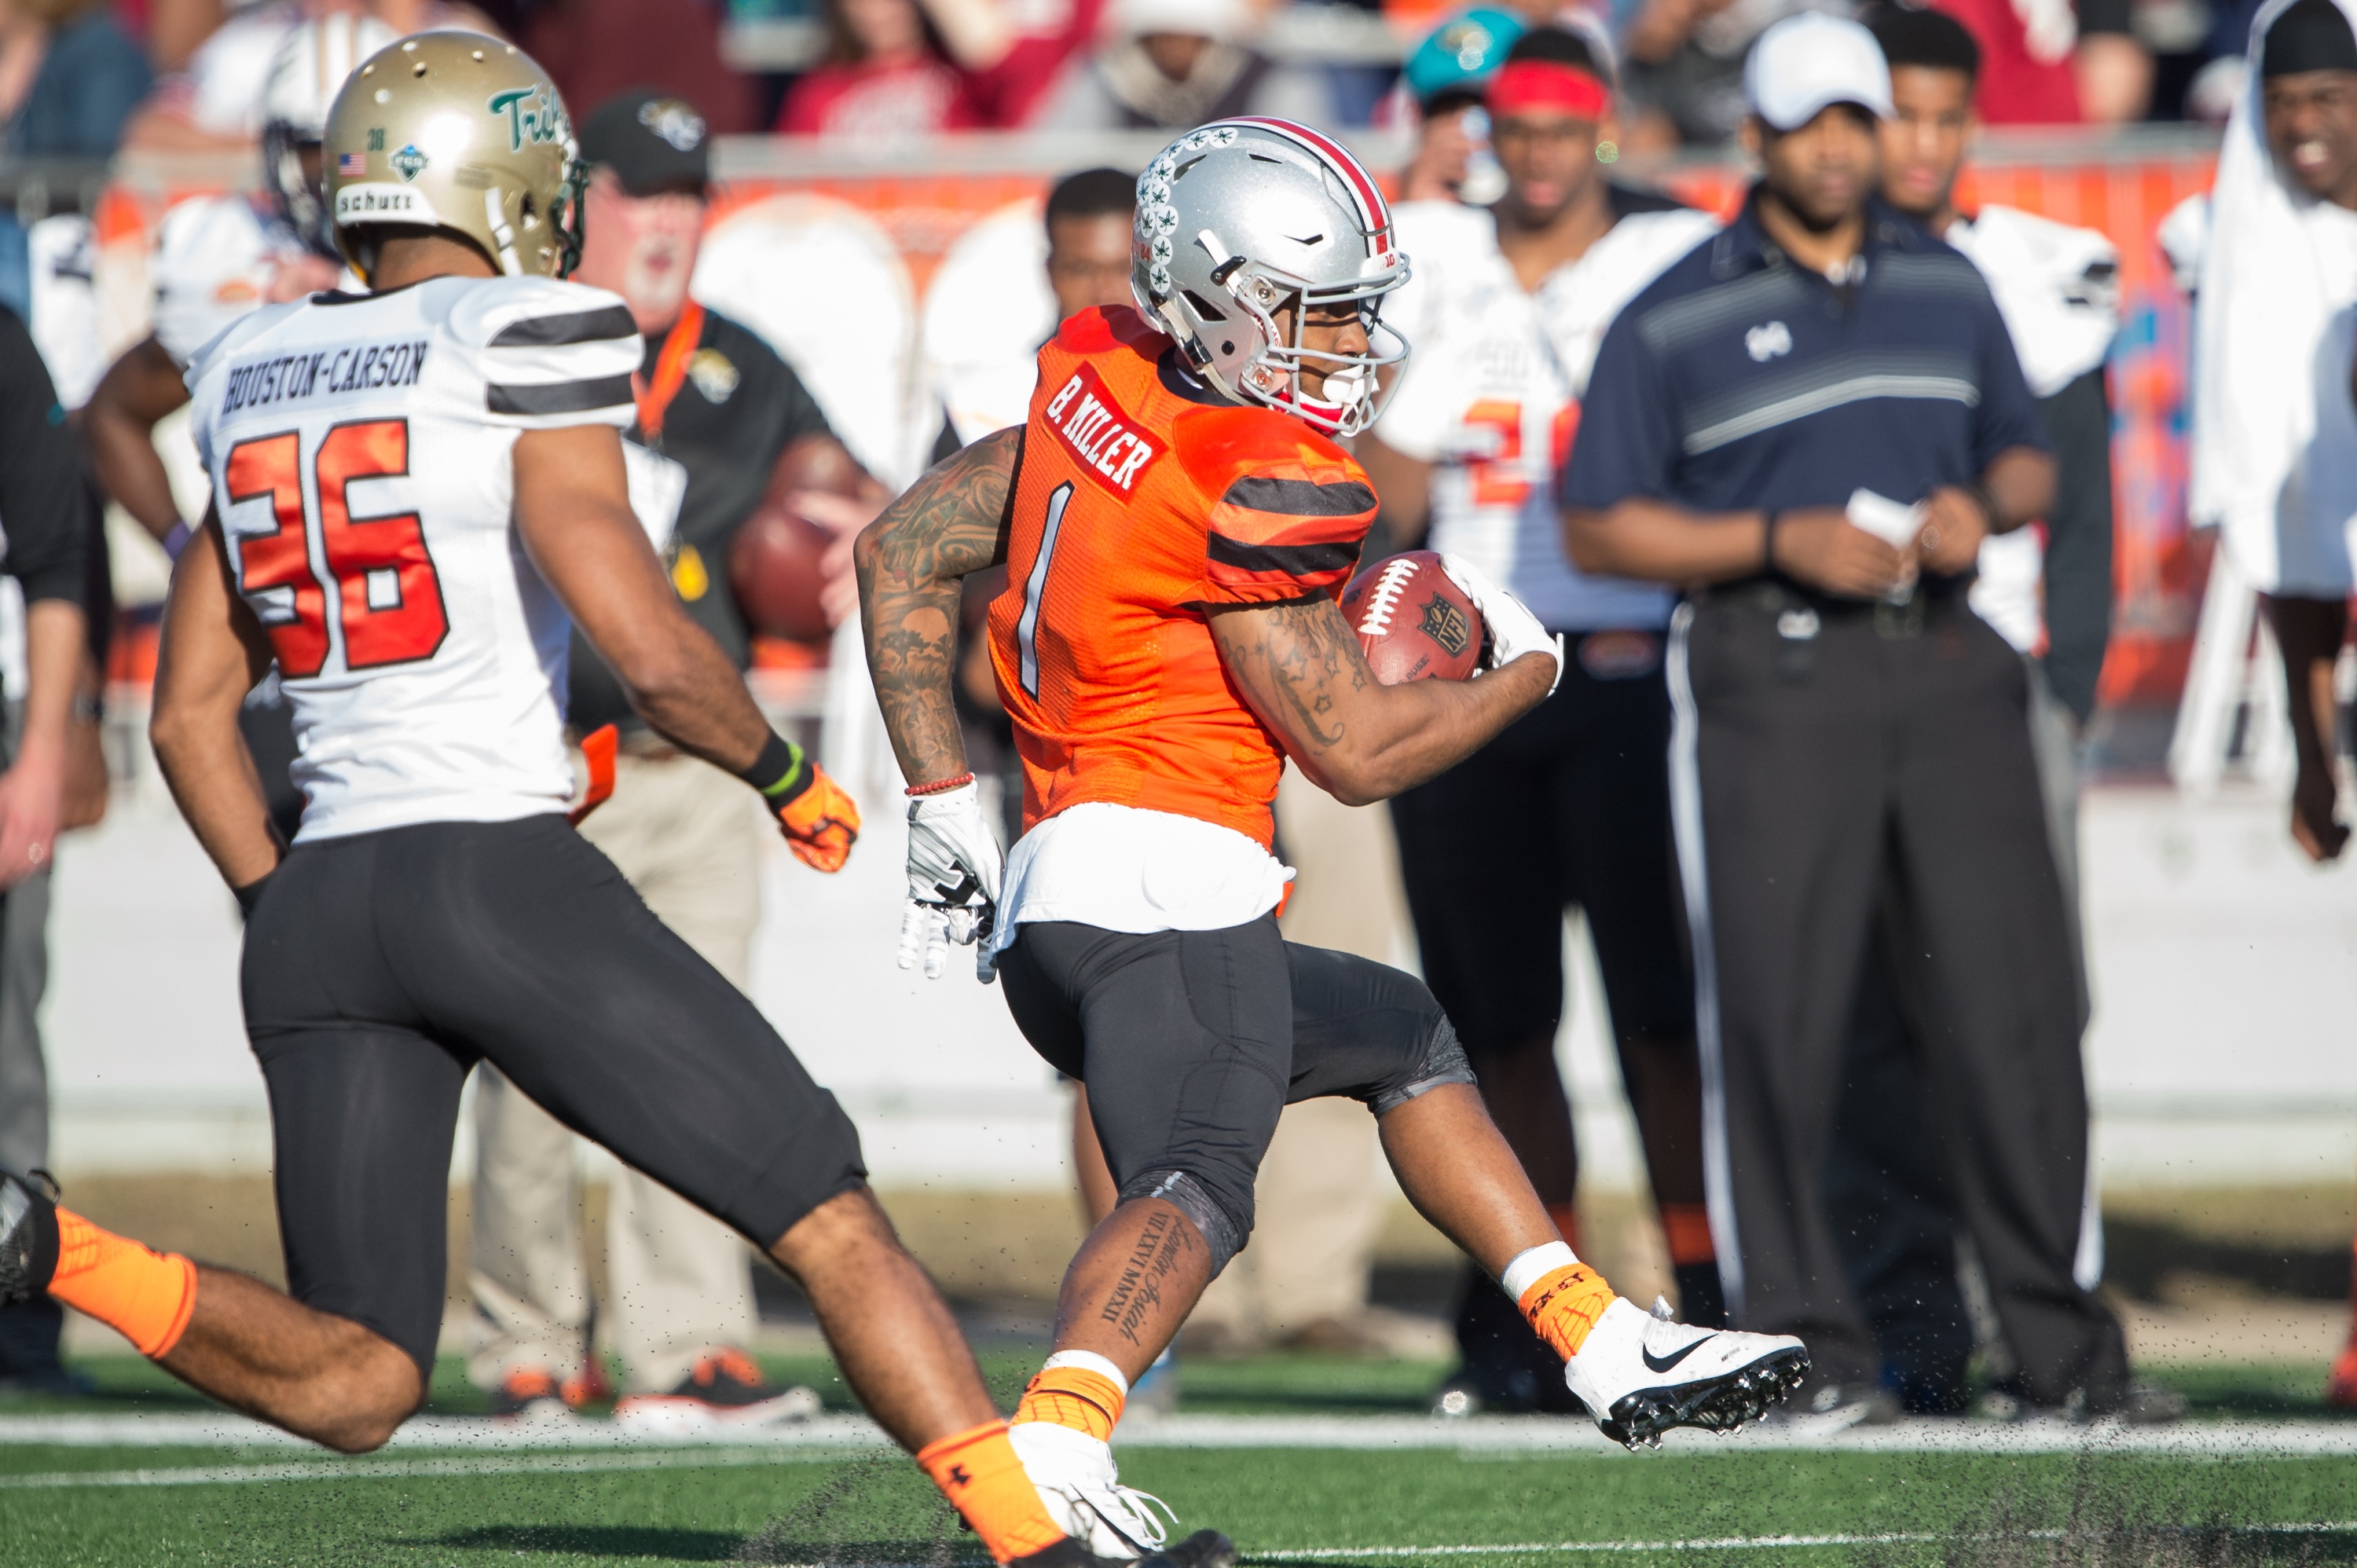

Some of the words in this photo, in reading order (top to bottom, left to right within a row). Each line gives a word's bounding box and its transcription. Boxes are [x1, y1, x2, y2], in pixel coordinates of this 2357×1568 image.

[222, 340, 427, 415] HOUSTON-CARSON
[1047, 374, 1083, 425] B.
[1061, 392, 1153, 490] MILLER
[225, 416, 451, 680] 36
[1017, 478, 1076, 703] 1
[1439, 612, 1467, 651] NFL
[1129, 1228, 1160, 1269] XXVI
[1148, 1211, 1169, 1233] VII
[1102, 1266, 1142, 1323] MMXII
